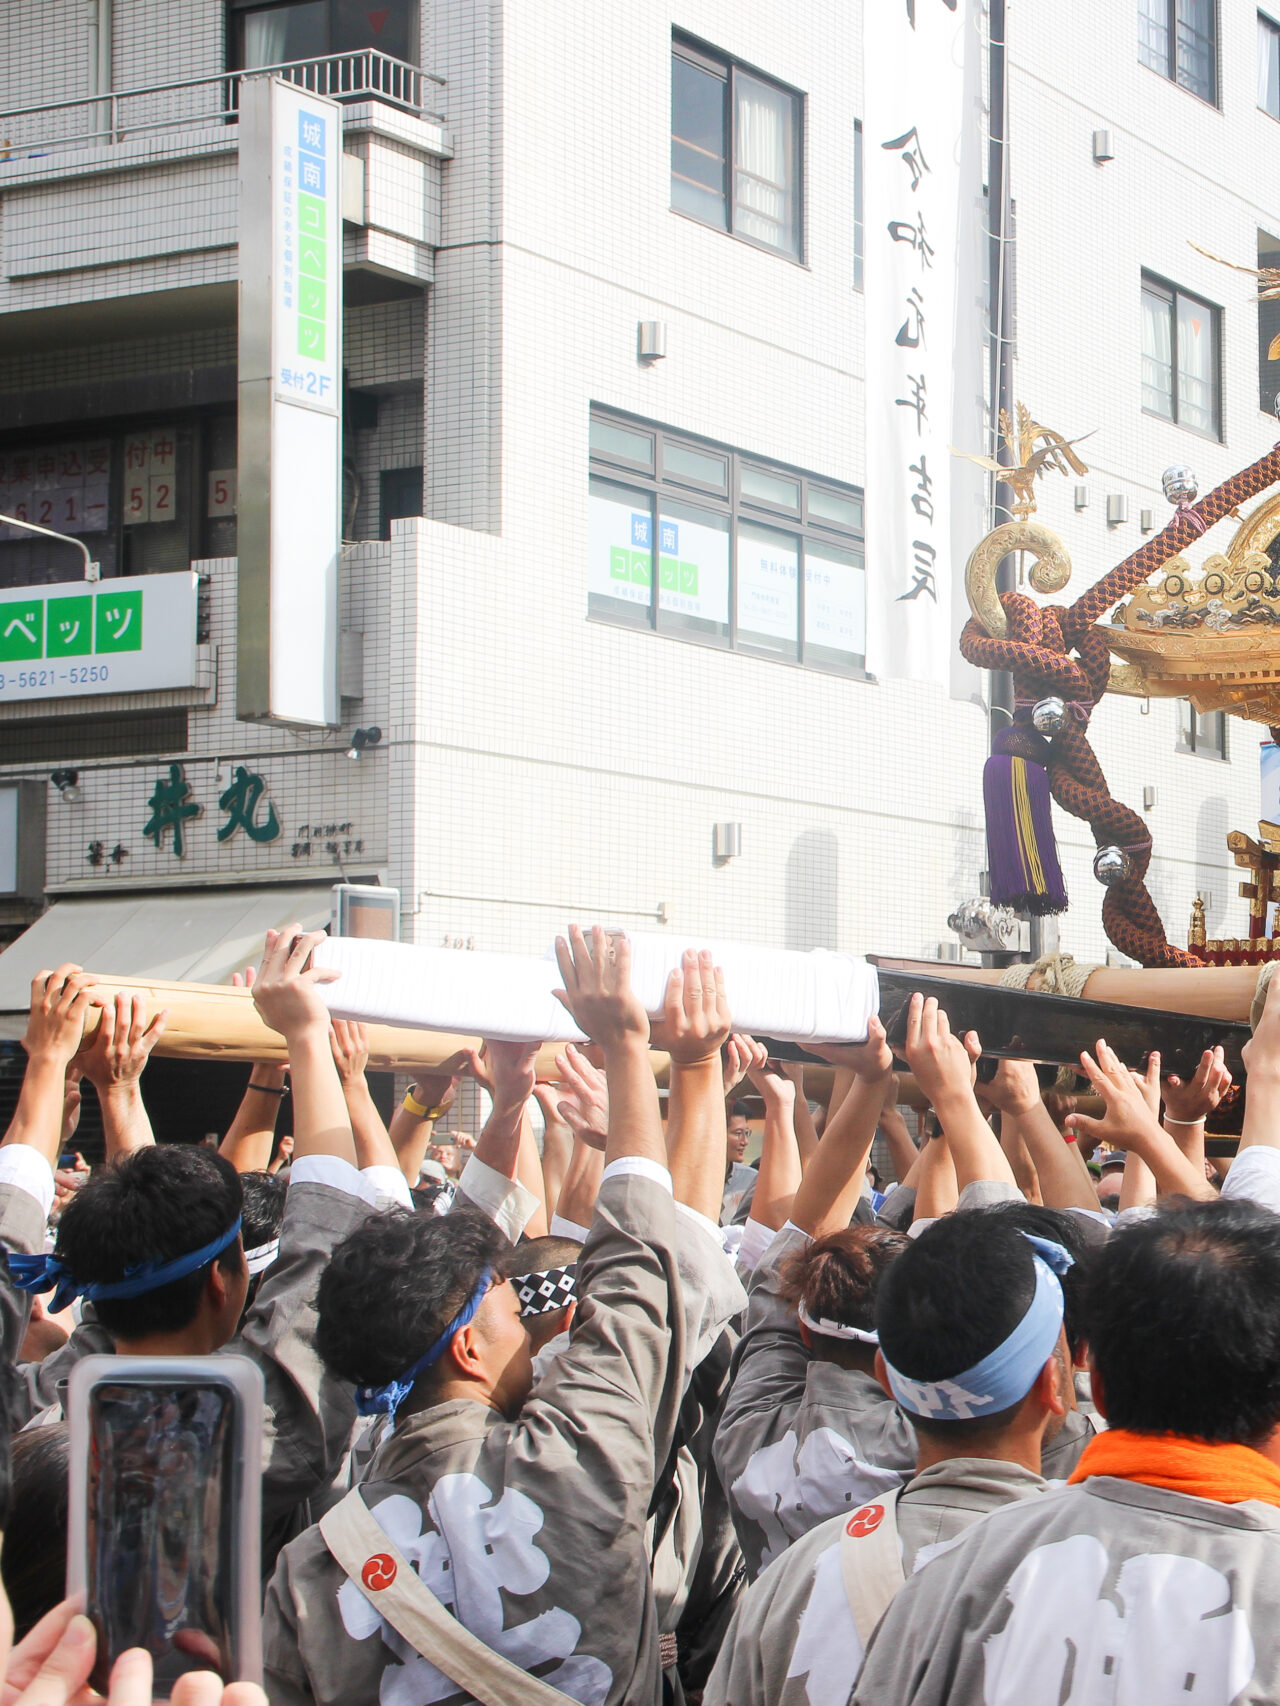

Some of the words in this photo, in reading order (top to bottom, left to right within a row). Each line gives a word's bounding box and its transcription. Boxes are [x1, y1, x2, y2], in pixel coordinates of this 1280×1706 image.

[300, 115, 325, 356] 城南コベッツ
[280, 366, 332, 397] 受付2F
[0, 436, 174, 486] 業申込受付中
[632, 518, 677, 552] 城南
